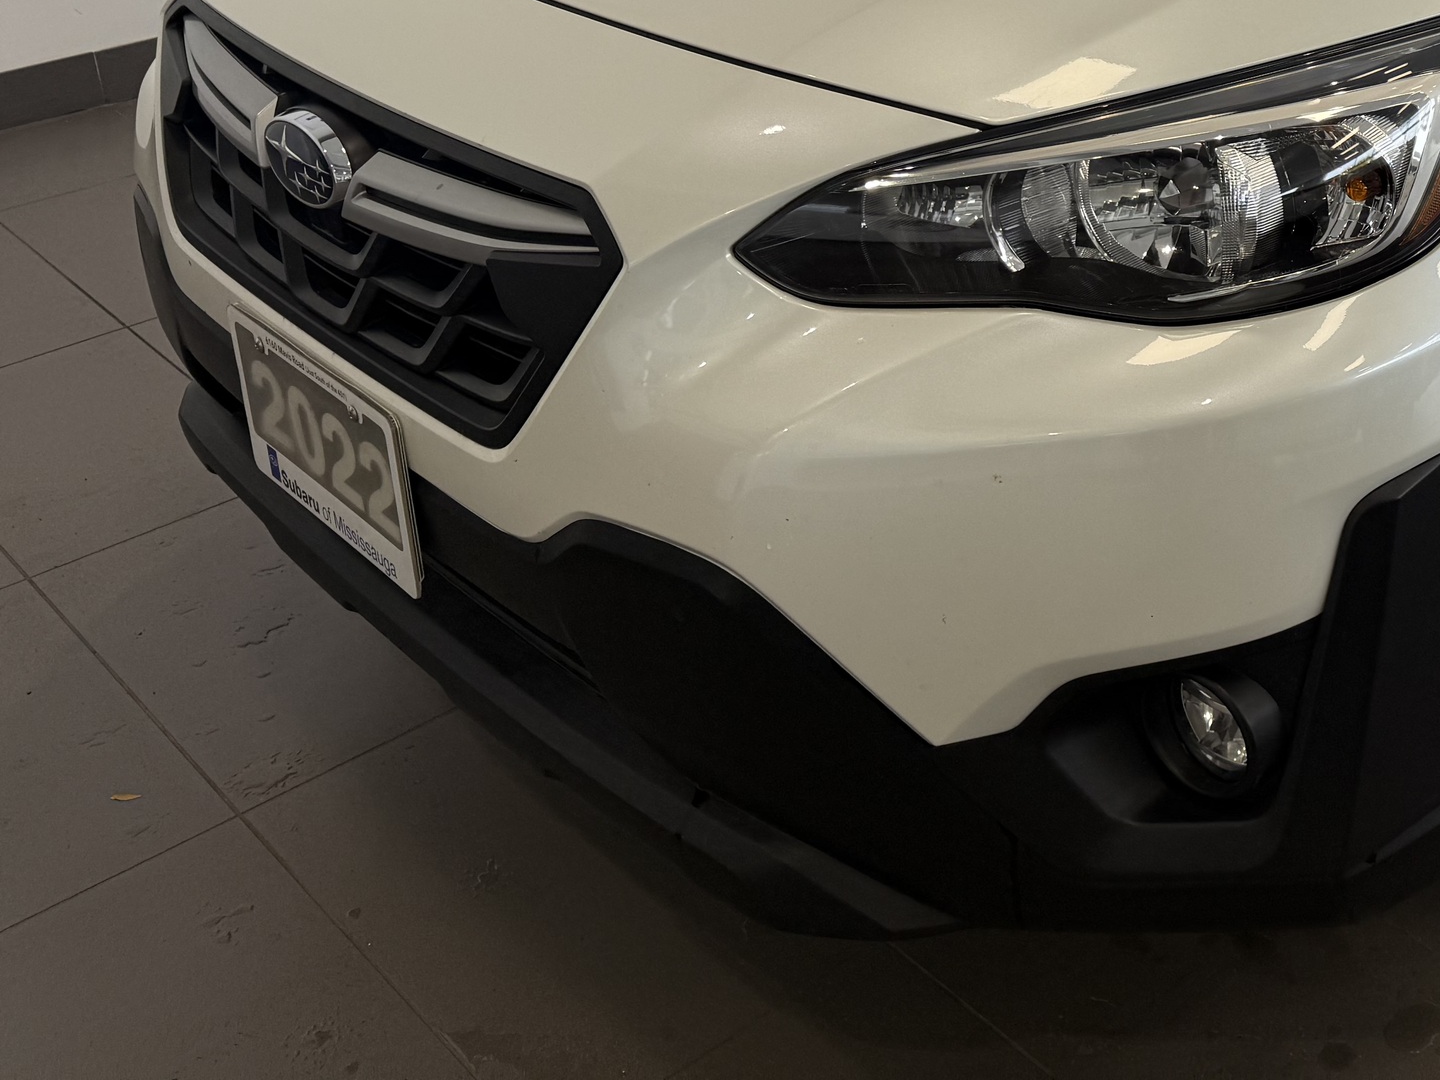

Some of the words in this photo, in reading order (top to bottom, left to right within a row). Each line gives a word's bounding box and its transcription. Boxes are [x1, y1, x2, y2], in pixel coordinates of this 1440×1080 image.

[251, 360, 403, 551] 2022
[281, 469, 320, 514] Subaru
[321, 505, 333, 524] of
[332, 510, 398, 580] Mississauga
